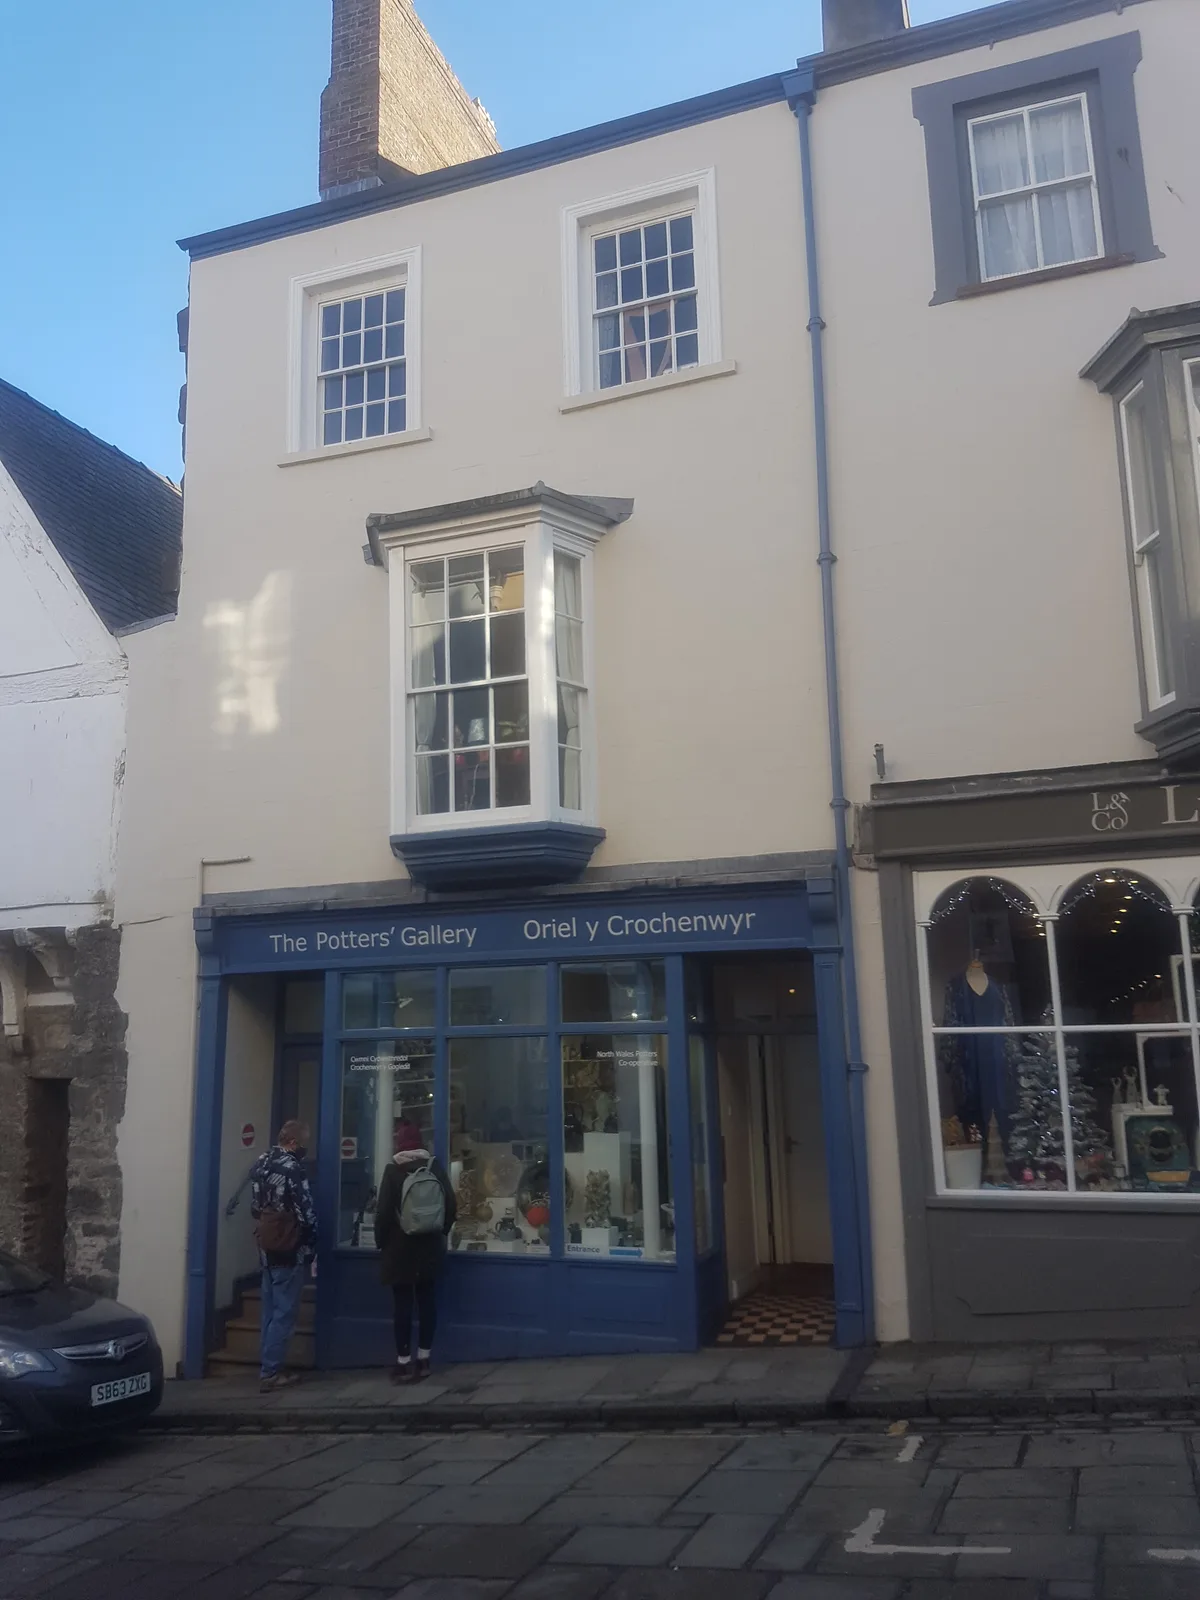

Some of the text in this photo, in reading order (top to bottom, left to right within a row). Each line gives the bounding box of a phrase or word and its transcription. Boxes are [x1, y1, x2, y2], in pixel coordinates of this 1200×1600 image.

[1160, 785, 1200, 824] L
[269, 933, 308, 953] The
[401, 925, 477, 947] Gallery
[523, 912, 756, 942] Oriel y Crochenwyr
[596, 1050, 615, 1058] North
[615, 1050, 635, 1058] Wales
[618, 1059, 659, 1067] Co-opeve
[567, 1244, 601, 1253] Entrance
[97, 1374, 147, 1401] SB63 ZXG
